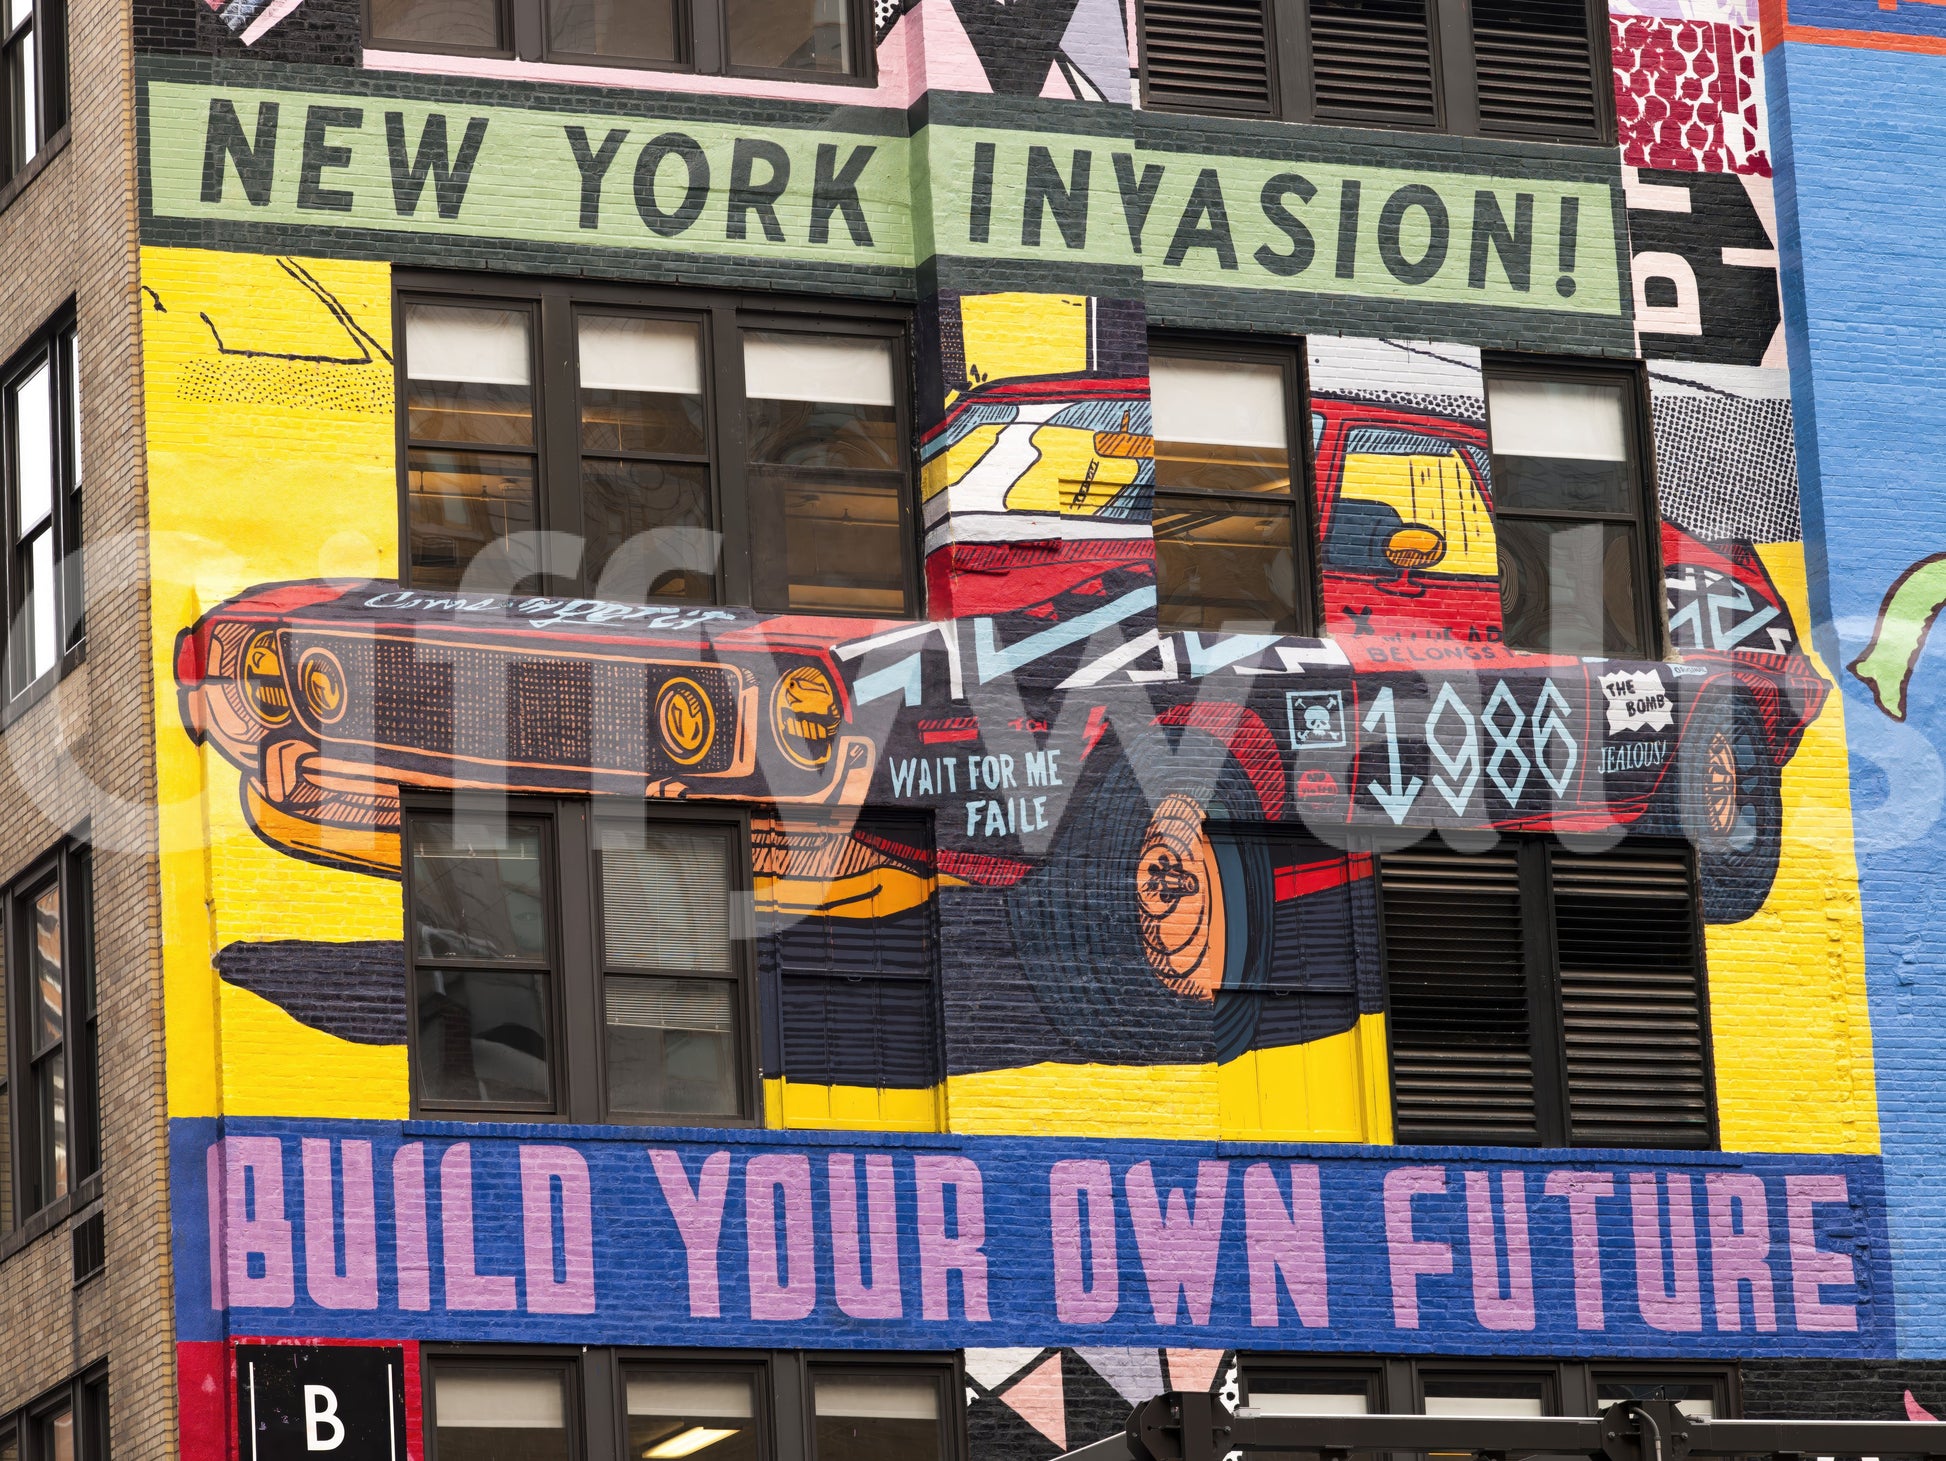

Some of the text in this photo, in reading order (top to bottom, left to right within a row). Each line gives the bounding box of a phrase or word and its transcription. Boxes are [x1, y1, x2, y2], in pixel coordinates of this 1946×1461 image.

[200, 98, 488, 219] NEW
[564, 126, 878, 248] YORK
[969, 142, 1578, 298] INVASION!
[1366, 647, 1495, 663] BELONGS
[1606, 679, 1636, 697] THE
[1625, 694, 1665, 717] BOMB
[889, 749, 1063, 798] WAIT FOR ME
[1362, 678, 1578, 825] 1986
[1598, 740, 1667, 774] JEALOUS!
[965, 796, 1049, 837] FAILE
[206, 1135, 1858, 1332] BUILD YOUR OWN FUTURE
[303, 1384, 346, 1451] B
